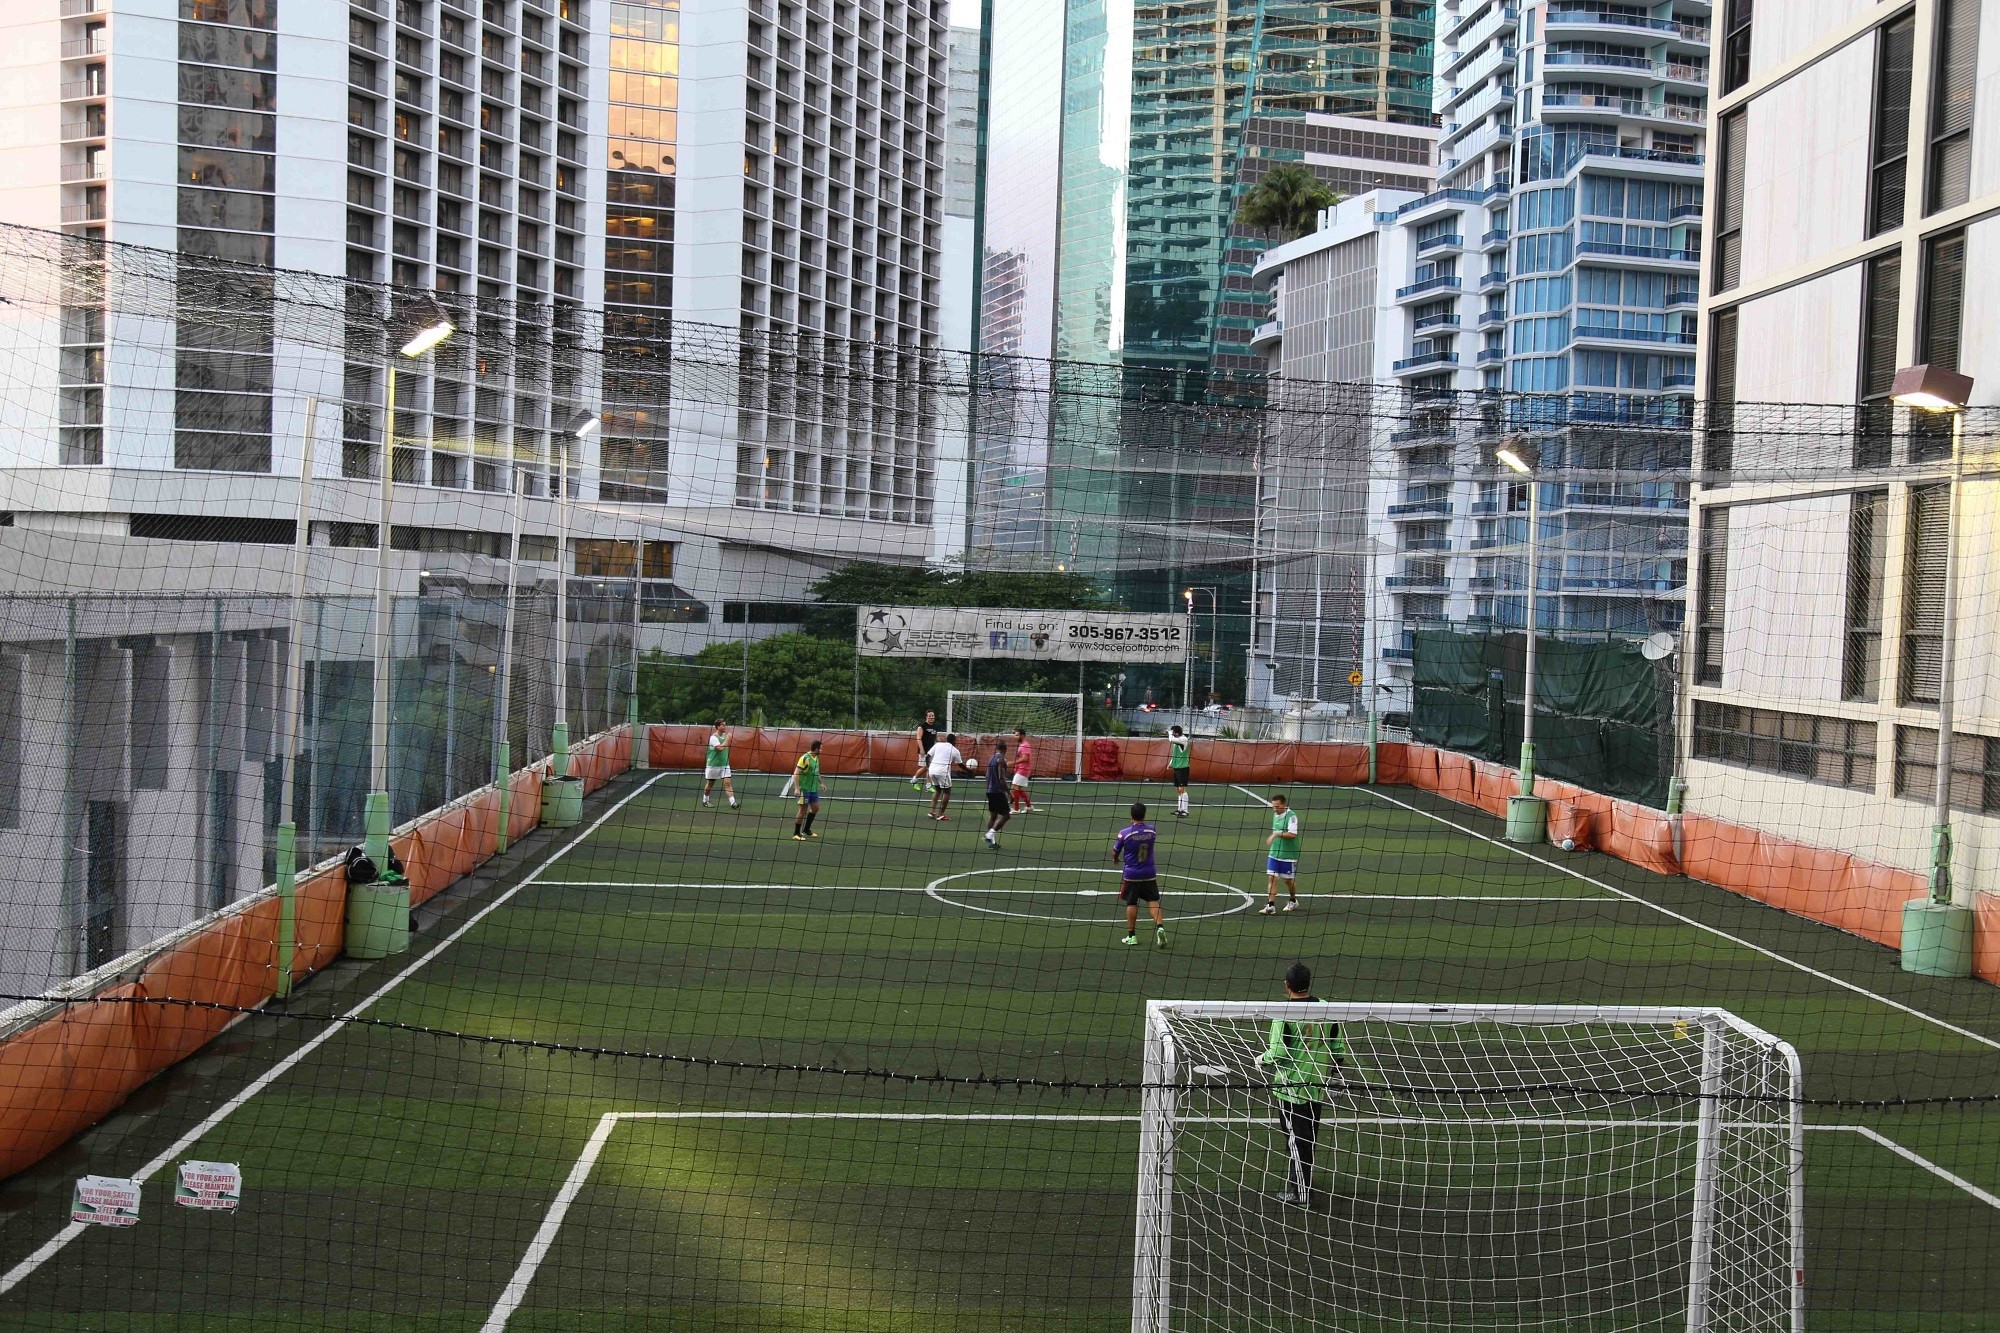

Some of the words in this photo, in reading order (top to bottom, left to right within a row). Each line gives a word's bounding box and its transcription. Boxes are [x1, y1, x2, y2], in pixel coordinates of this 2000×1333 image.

[985, 618, 1012, 630] Find
[1018, 622, 1034, 630] us
[1038, 622, 1059, 631] on:
[910, 631, 979, 641] SOCCER
[1068, 625, 1181, 640] 305-967-3512
[904, 639, 984, 649] ROOFTOP
[196, 1173, 212, 1182] YOUR
[184, 1180, 203, 1189] PLEASE
[95, 1189, 111, 1197] YOUR
[112, 1190, 135, 1200] SAFETY
[80, 1196, 102, 1204] PLEASE
[103, 1198, 133, 1207] MAINTAIN
[176, 1196, 193, 1204] AWAY
[73, 1212, 91, 1220] AWAY
